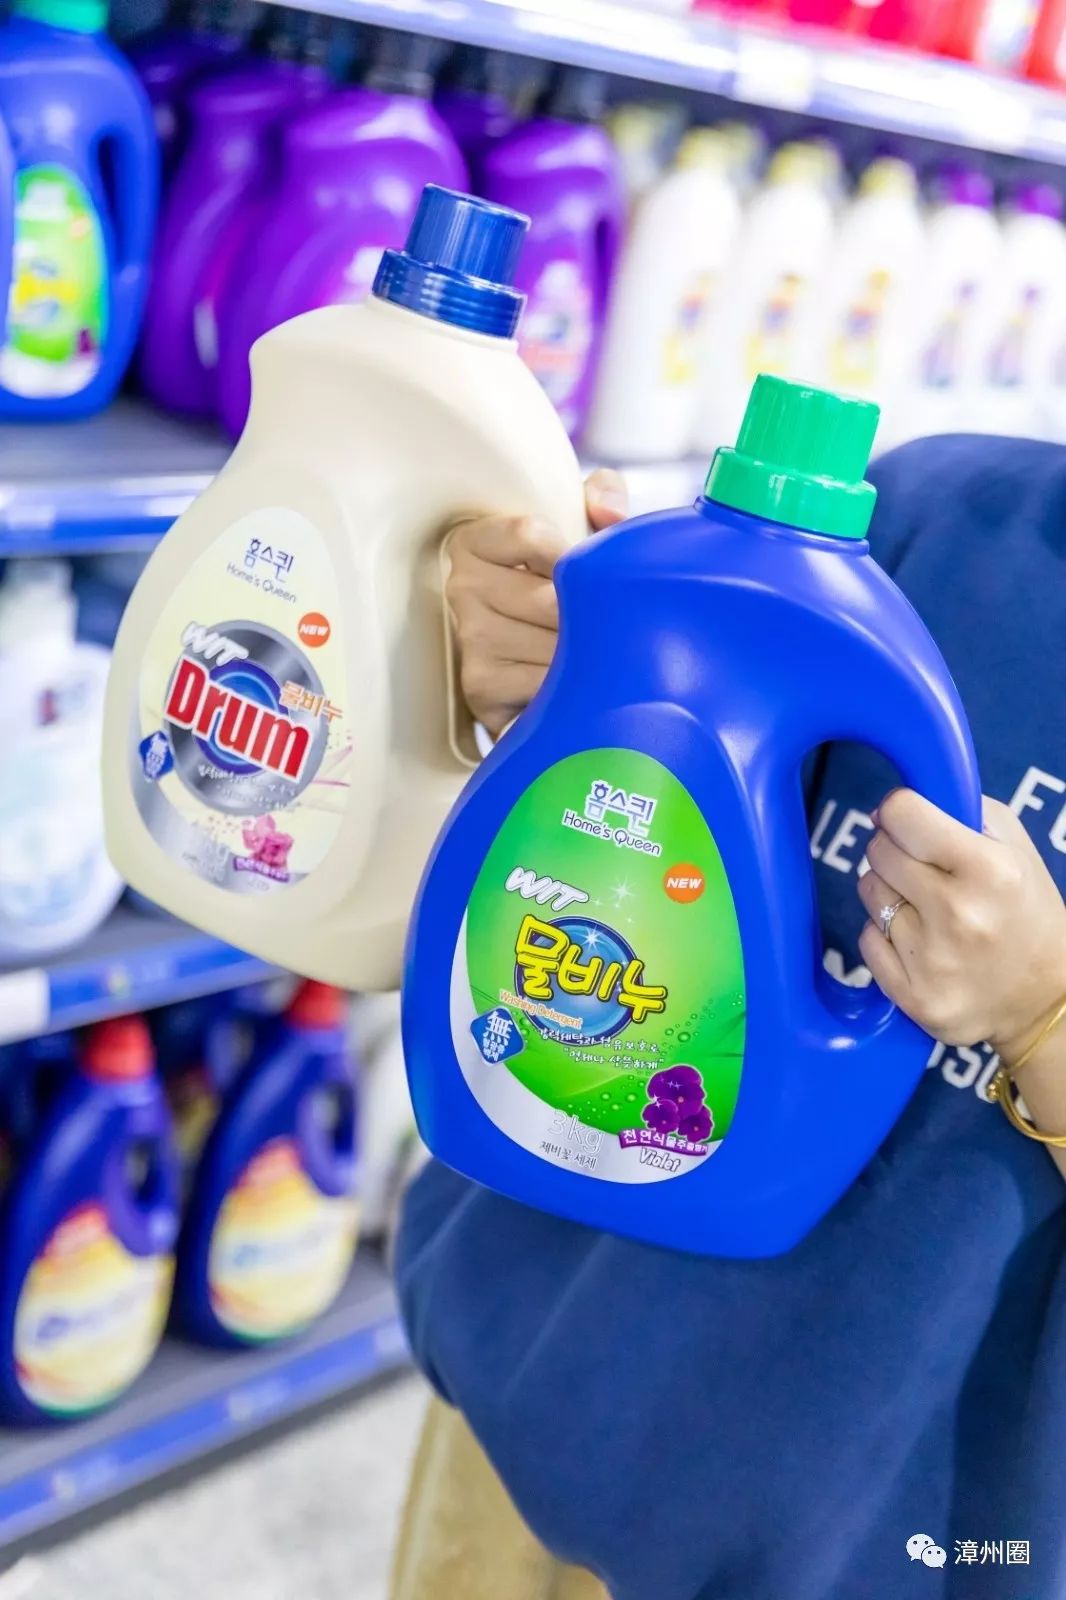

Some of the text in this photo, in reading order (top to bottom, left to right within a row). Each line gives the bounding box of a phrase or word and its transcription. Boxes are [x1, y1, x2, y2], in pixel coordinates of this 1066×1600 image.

[245, 538, 294, 583] 홈스퀸
[226, 562, 297, 603] Home's Queen
[181, 621, 249, 666] WIT
[300, 623, 328, 637] NEW
[165, 656, 311, 781] Drum
[280, 680, 343, 722] 물비누
[585, 780, 656, 837] 홈스퀸
[563, 810, 661, 857] Home's Queen
[504, 865, 589, 912] WIT
[666, 877, 702, 889] NEW
[515, 914, 668, 1022] 물비누
[483, 1011, 513, 1045] 無
[574, 1153, 597, 1170] 세제
[640, 1147, 681, 1172] Violet
